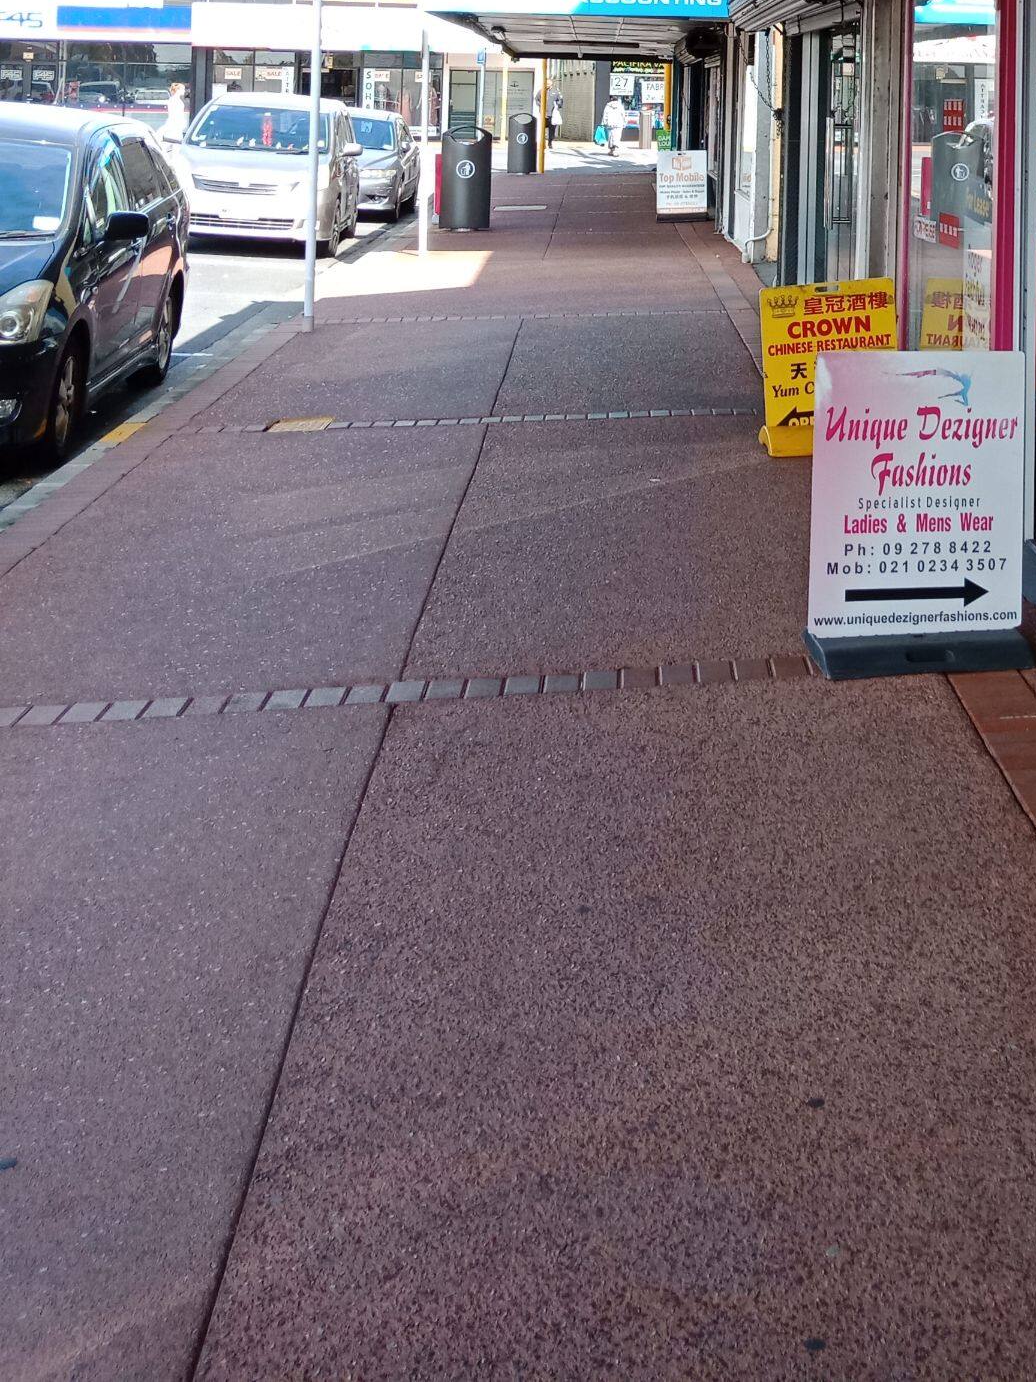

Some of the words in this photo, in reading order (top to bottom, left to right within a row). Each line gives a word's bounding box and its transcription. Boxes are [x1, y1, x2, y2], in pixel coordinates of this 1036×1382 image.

[803, 290, 888, 315] 皇冠酒樓
[787, 315, 871, 338] CROWN
[768, 340, 813, 357] CHINESE
[816, 334, 891, 352] RESTAURANT
[772, 384, 799, 398] Yum
[804, 381, 814, 394] C
[825, 406, 907, 449] Unique
[917, 407, 1018, 449] Dezigner
[870, 453, 972, 496] Fashions
[858, 496, 922, 510] Specialist
[926, 496, 981, 510] Designer
[844, 514, 887, 535] Ladies
[896, 514, 907, 533] &
[915, 513, 951, 532] Mens
[959, 513, 994, 532] Wear
[844, 543, 875, 557] Ph:
[882, 542, 903, 556] 09
[910, 542, 941, 555] 278
[949, 541, 991, 555] 8422
[826, 561, 872, 575] Mob:
[879, 560, 909, 573] 021
[917, 559, 959, 573] 0234
[966, 557, 1007, 571] 3507
[814, 609, 1018, 628] www.uniquedezignerfashions.com
